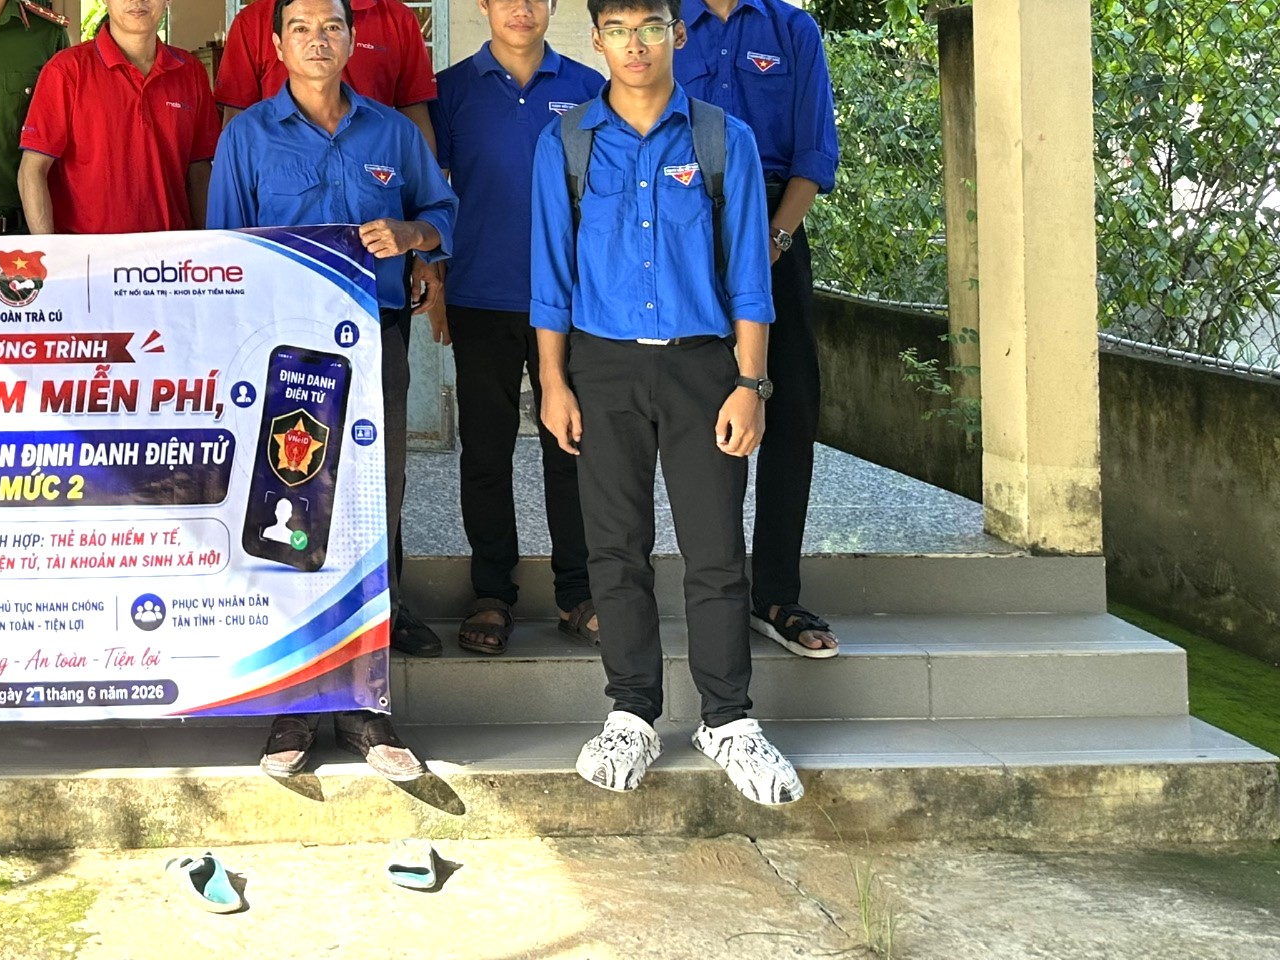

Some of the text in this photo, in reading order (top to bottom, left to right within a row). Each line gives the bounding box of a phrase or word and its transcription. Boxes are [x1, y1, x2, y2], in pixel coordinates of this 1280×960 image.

[114, 259, 243, 283] mobifone
[26, 309, 46, 322] TRÀ
[48, 309, 63, 322] CÚ
[44, 336, 107, 358] TRÌNH
[280, 370, 336, 389] ĐỊNH DANH
[40, 365, 139, 412] MIỄN
[150, 370, 224, 419] PHÍ,
[285, 387, 326, 403] ĐIỆN TỬ
[21, 443, 74, 471] ĐỊNH
[79, 443, 140, 466] DANH
[145, 437, 194, 470] ĐIỆN
[201, 435, 230, 465] TỬ
[67, 474, 85, 499] 2
[12, 534, 45, 550] HỢP:
[51, 529, 75, 547] THẺ
[80, 529, 106, 547] BẢO
[150, 532, 158, 545] Y
[164, 527, 181, 546] TẾ,
[47, 554, 66, 569] TÀI
[71, 552, 116, 568] KHOẢN
[120, 555, 138, 567] AN
[142, 554, 173, 567] SINH
[177, 551, 194, 566] XÃ
[199, 549, 221, 568] HỘI
[15, 602, 33, 615] TỤC
[35, 601, 69, 613] NHANH
[71, 600, 105, 611] CHÓNG
[172, 594, 269, 611] PHỤC VỤ NHÂN DÂN
[10, 618, 35, 630] TOÀN
[45, 618, 66, 632] TIỆN
[69, 619, 84, 633] LỢI
[193, 614, 215, 626] TÌNH
[225, 615, 245, 626] CHU
[248, 613, 269, 626] ĐÁO
[24, 649, 50, 671] An
[55, 651, 88, 668] toàn
[104, 646, 137, 670] Tiện
[141, 646, 161, 670] lợi
[46, 686, 84, 703] tháng
[87, 686, 96, 700] 6
[99, 686, 128, 700] năm
[131, 685, 164, 699] 2026
